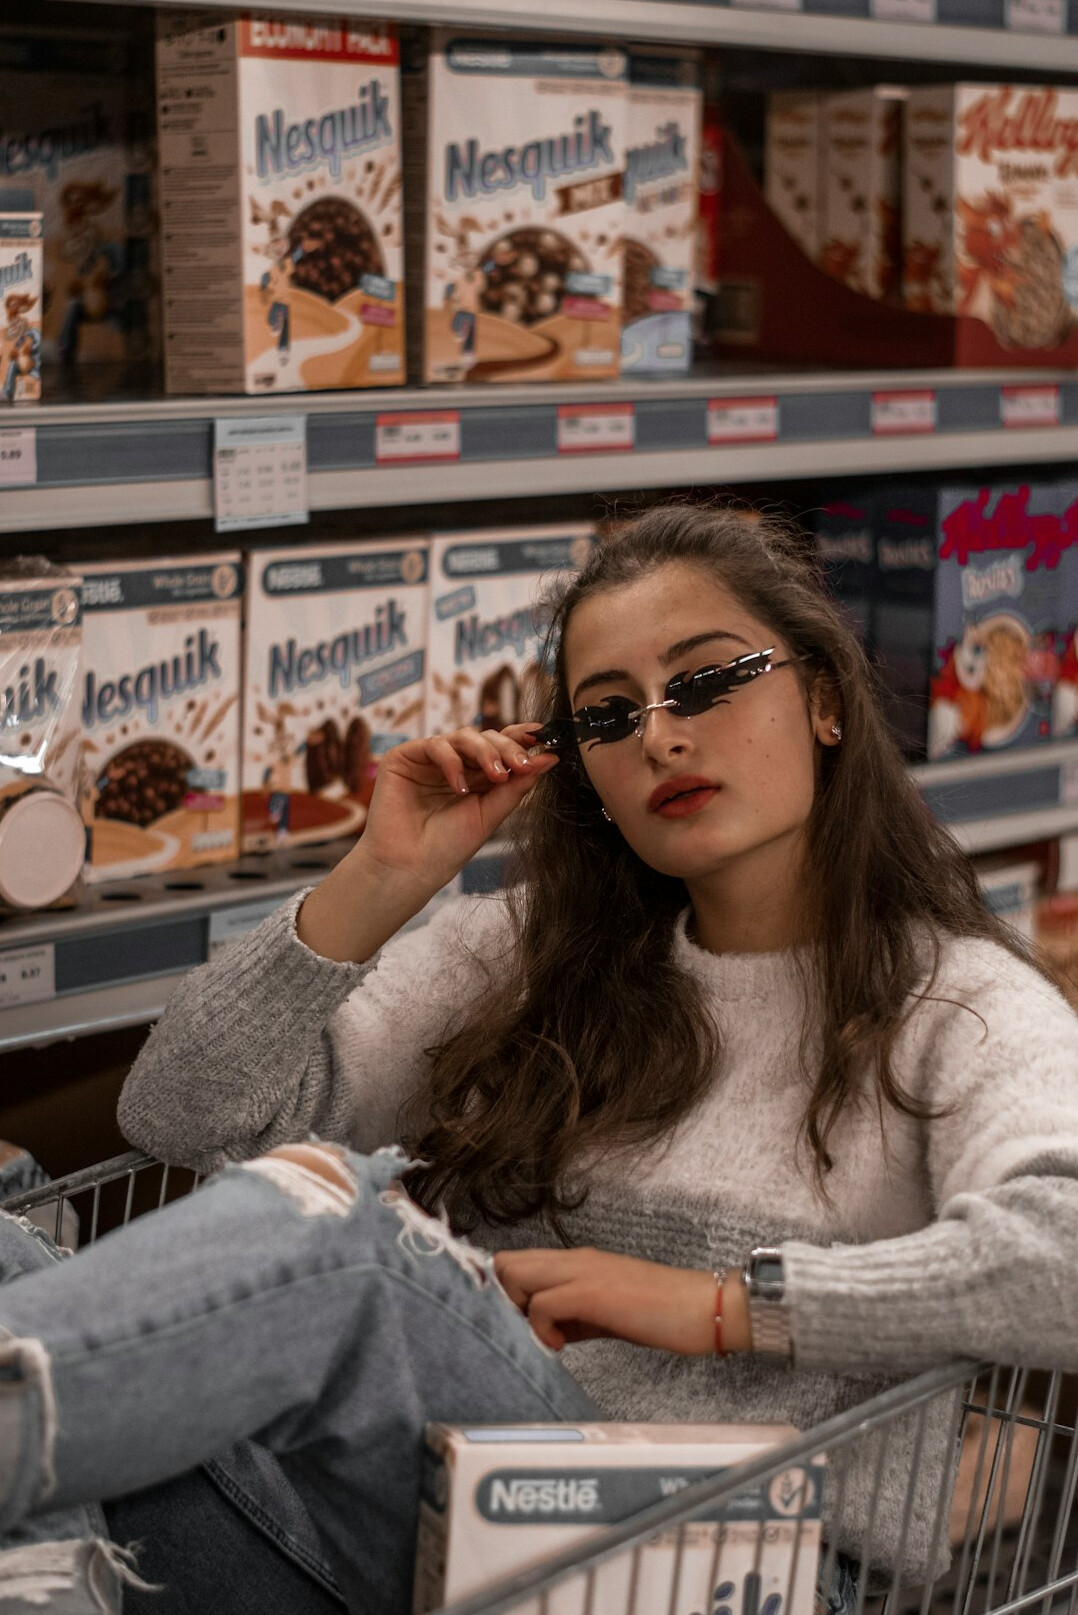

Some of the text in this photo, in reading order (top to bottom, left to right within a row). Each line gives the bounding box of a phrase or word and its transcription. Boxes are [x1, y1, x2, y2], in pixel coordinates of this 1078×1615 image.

[256, 79, 392, 179] Nesquik
[445, 110, 615, 201] Nesquik
[268, 599, 409, 699] Nesquik
[490, 1478, 599, 1515] Nestlé
